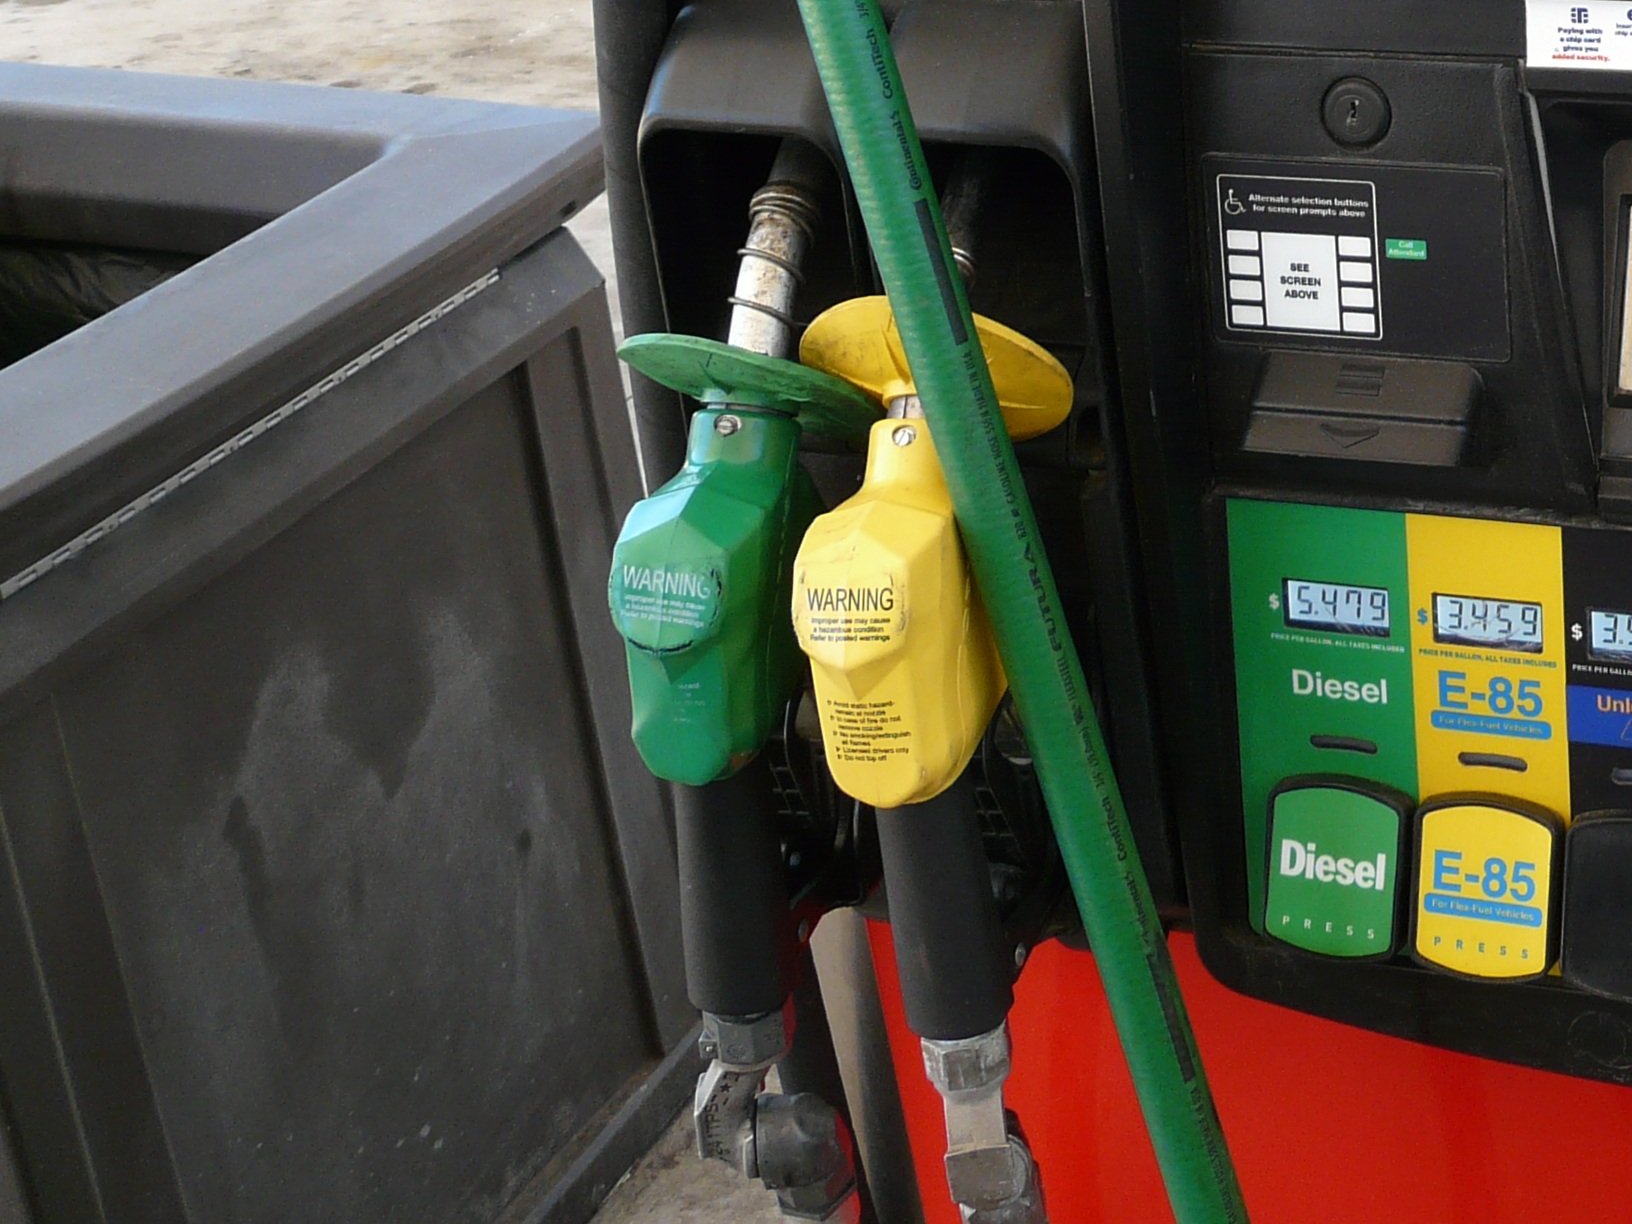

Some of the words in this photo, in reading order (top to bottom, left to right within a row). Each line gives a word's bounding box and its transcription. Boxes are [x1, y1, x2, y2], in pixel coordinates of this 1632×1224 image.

[1248, 193, 1289, 204] Alternate
[1291, 196, 1332, 206] selection
[1334, 197, 1369, 208] buttons
[1252, 204, 1266, 213] for
[1267, 205, 1297, 214] screen
[1299, 207, 1336, 218] prompts
[1338, 208, 1365, 218] above
[1290, 263, 1310, 273] SEE
[1280, 276, 1321, 286] SCREEN
[1284, 290, 1319, 300] ABOVE
[623, 565, 711, 599] WARNING
[807, 587, 894, 612] WARNING
[1292, 668, 1388, 704] Diesel
[1437, 670, 1543, 717] E-85
[1280, 839, 1386, 890] Diesel
[1433, 849, 1536, 902] E-85
